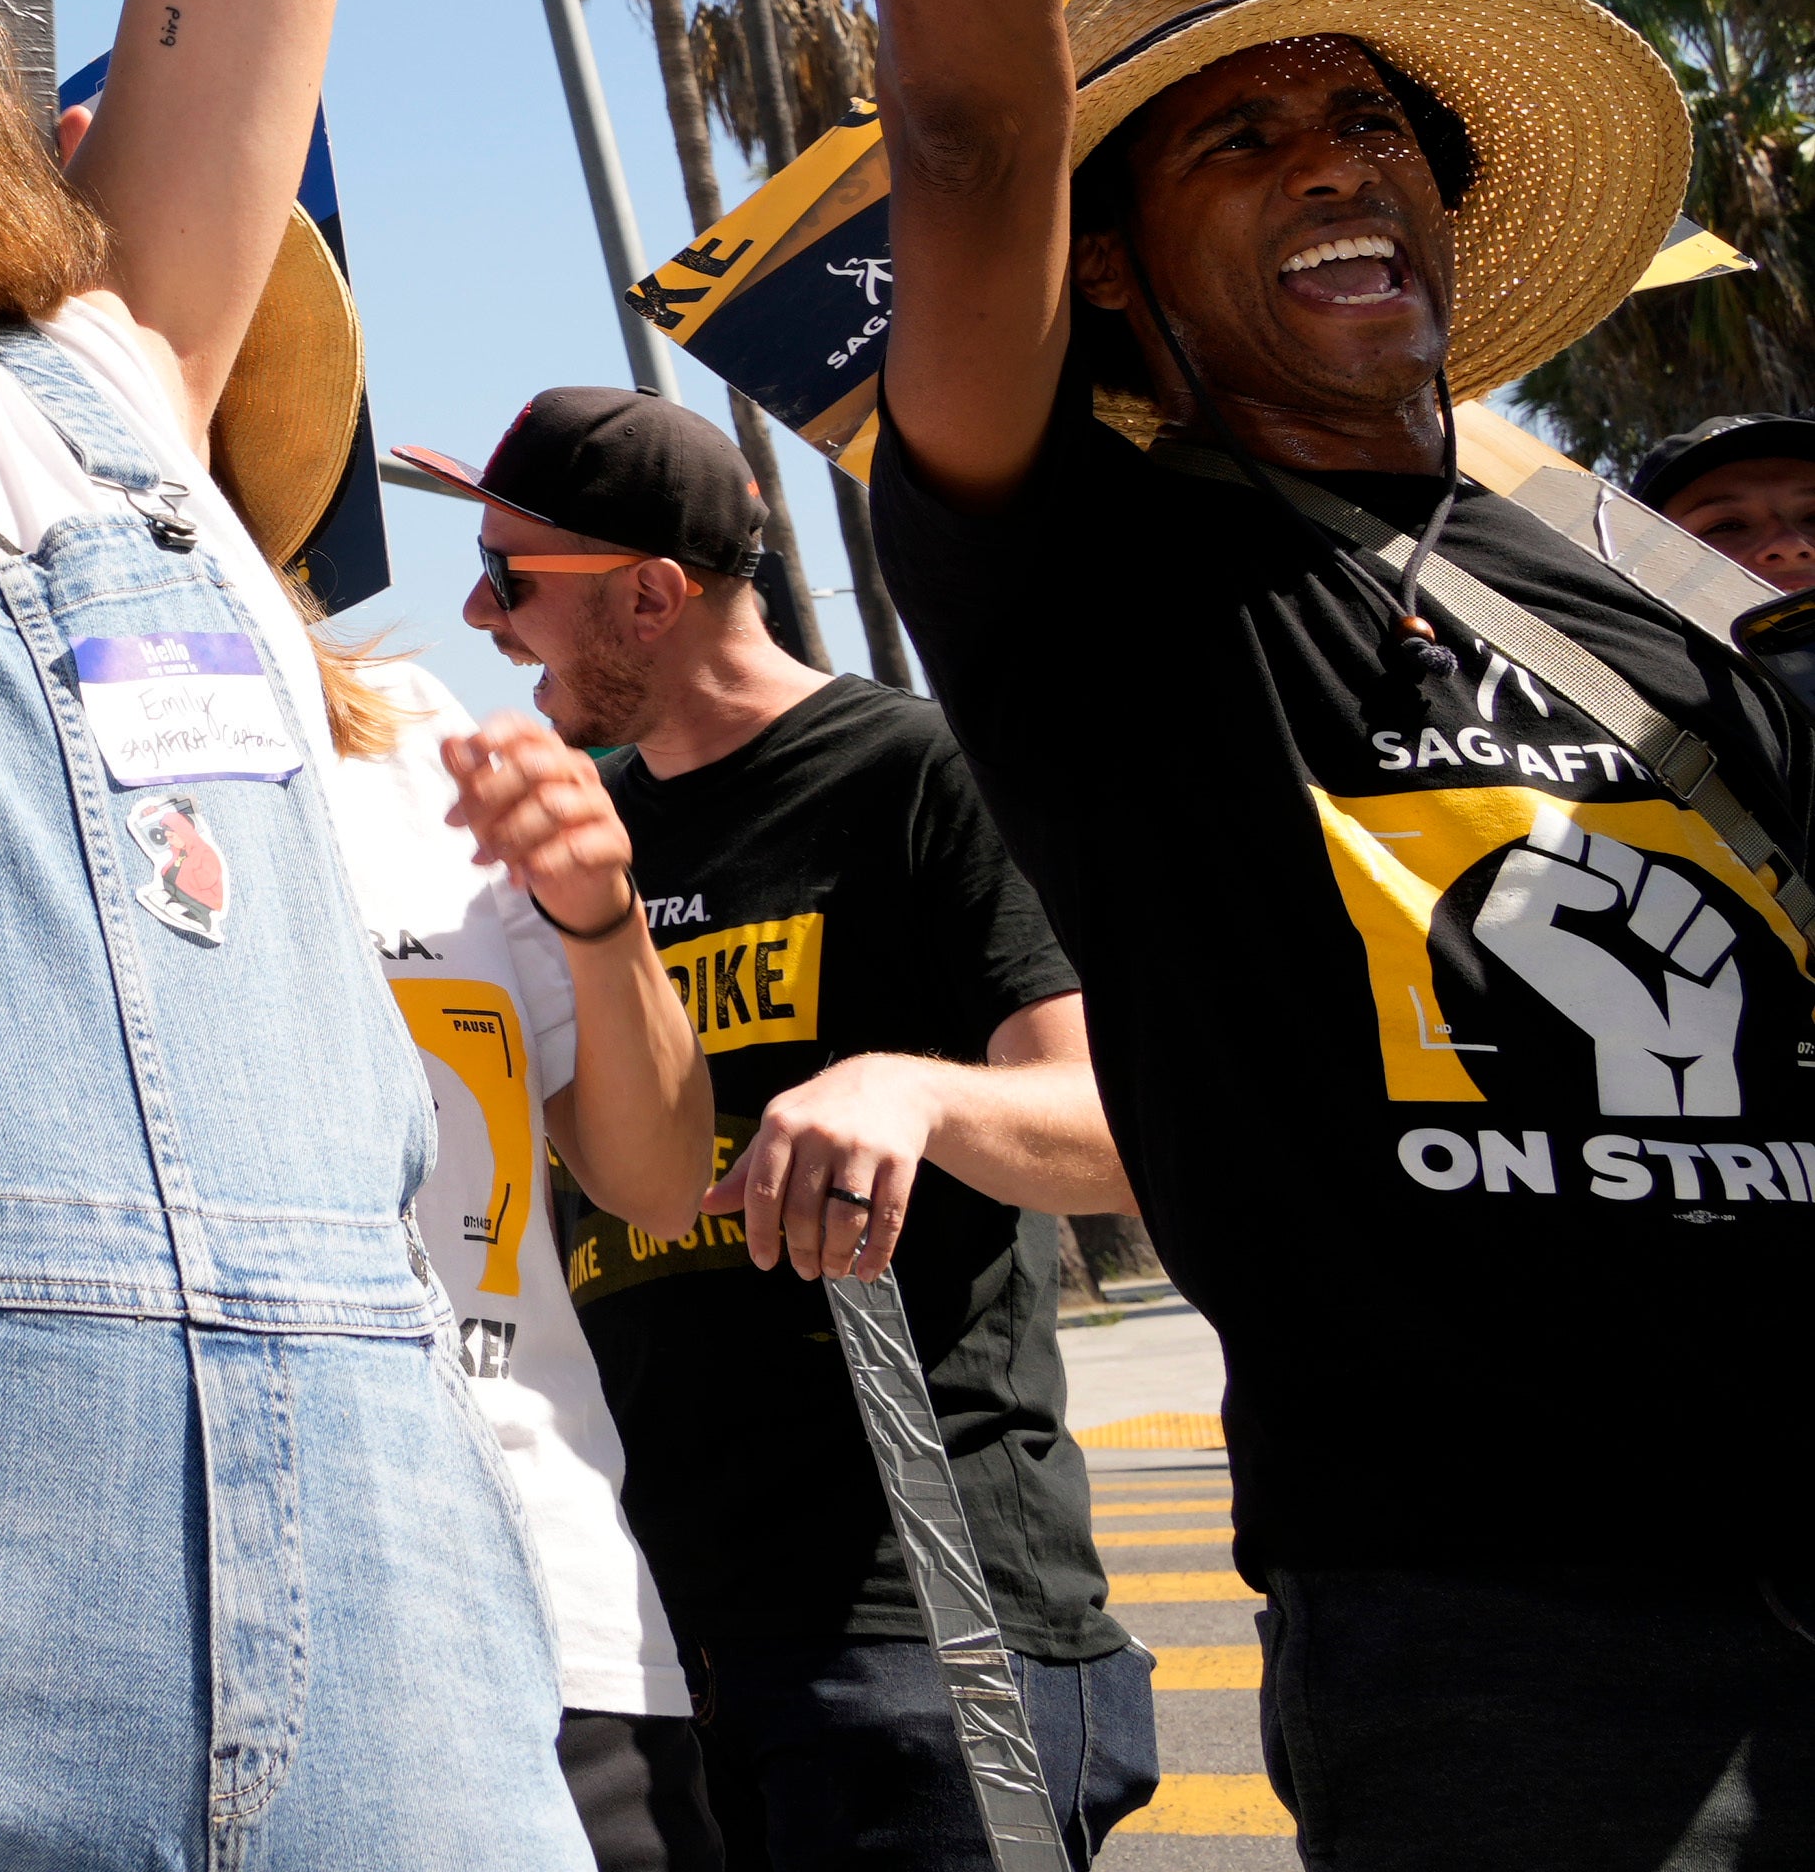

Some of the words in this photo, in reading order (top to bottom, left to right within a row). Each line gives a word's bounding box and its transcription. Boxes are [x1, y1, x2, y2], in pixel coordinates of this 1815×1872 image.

[159, 6, 180, 46] bird
[138, 638, 190, 664] Hello
[138, 686, 222, 741] Emily
[453, 1019, 496, 1035] PAUSE
[1434, 1024, 1452, 1035] HD
[1397, 1127, 1557, 1195] ON
